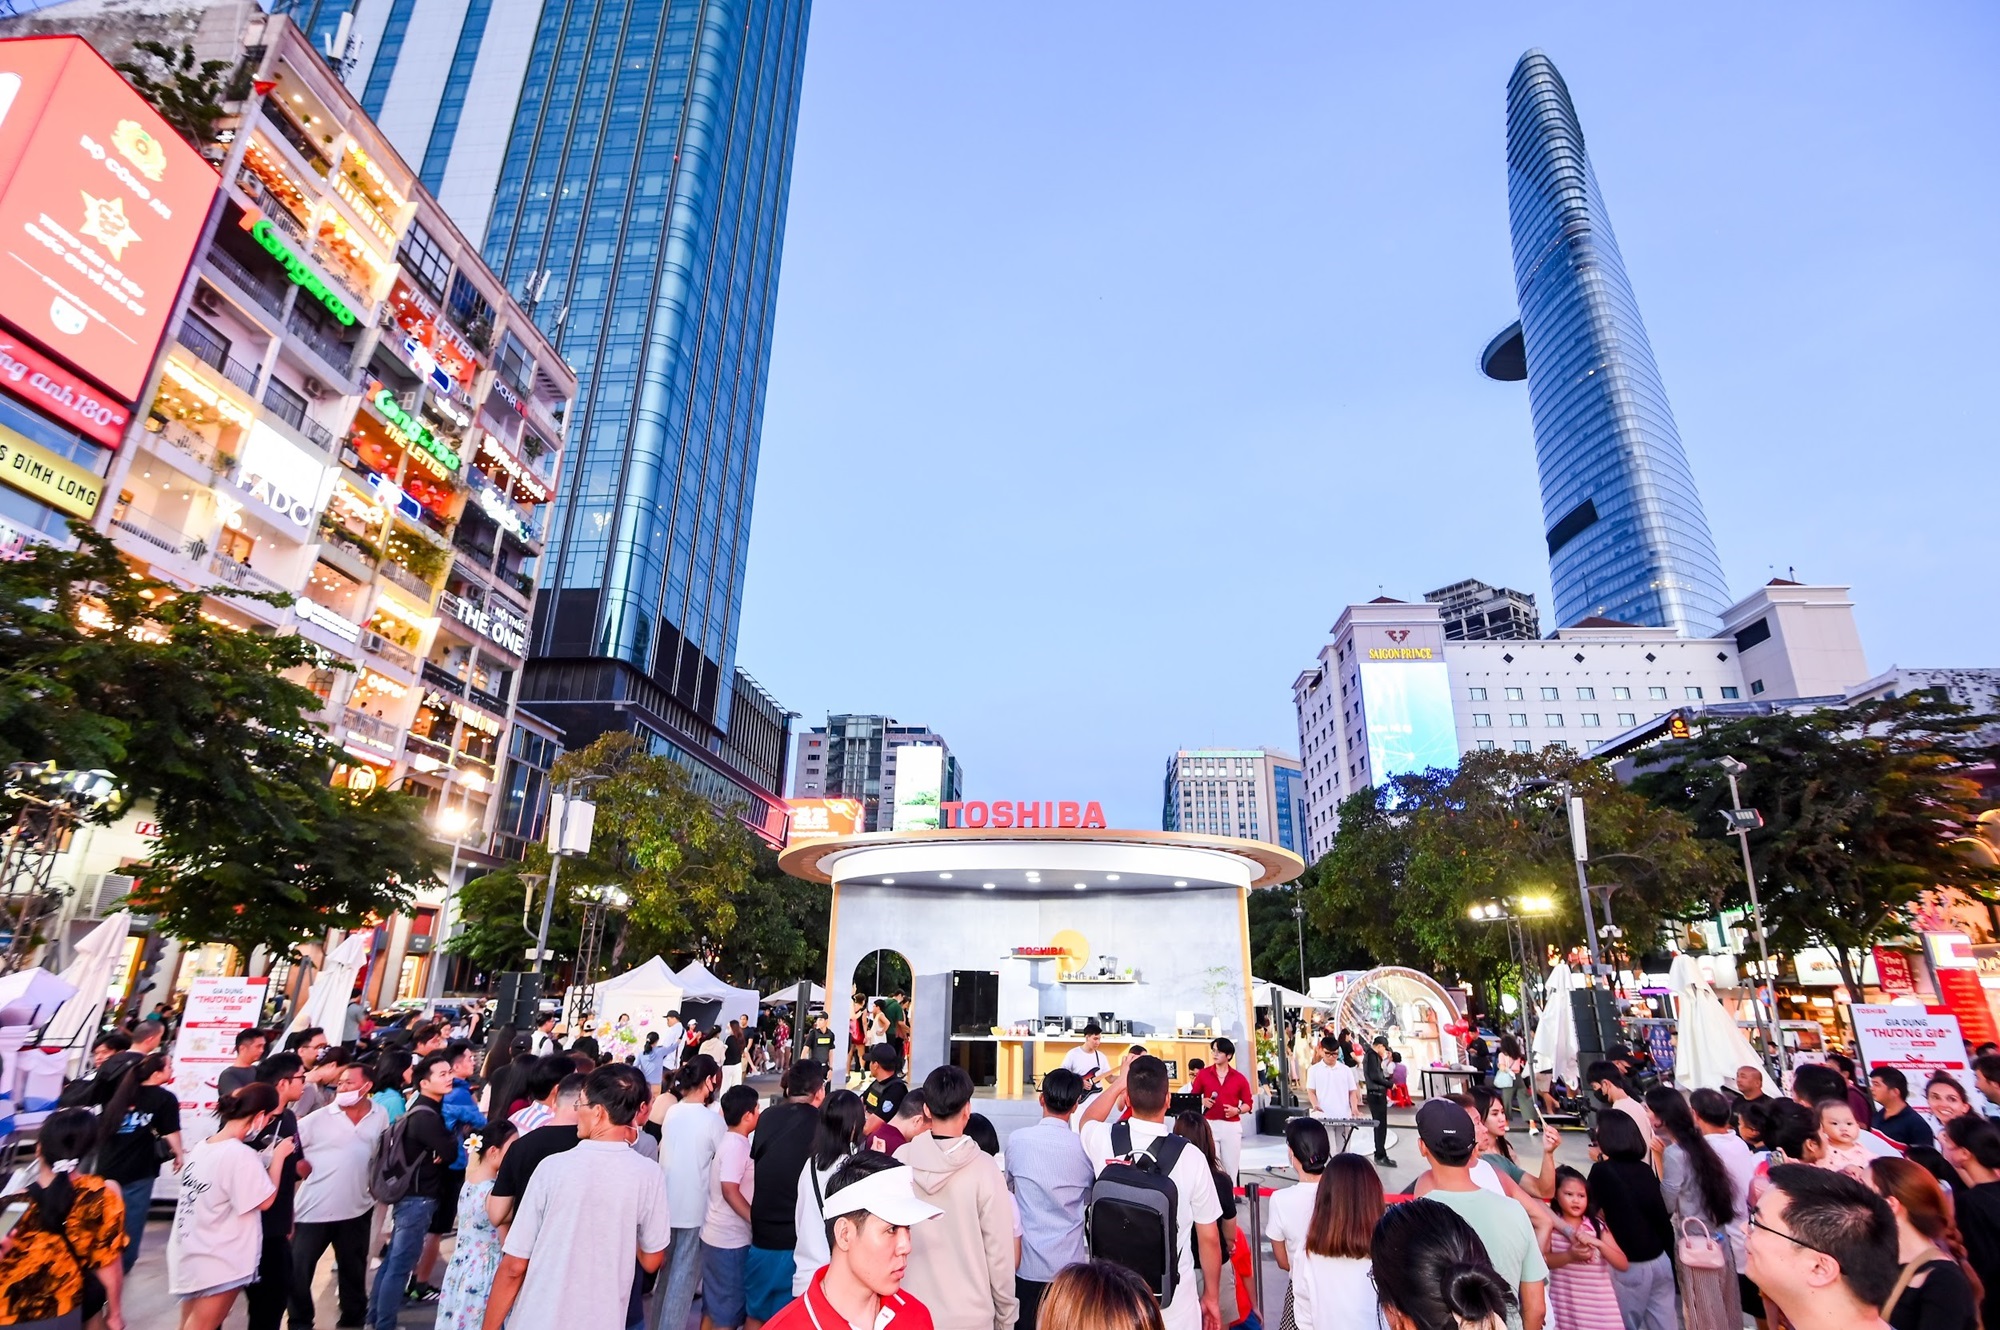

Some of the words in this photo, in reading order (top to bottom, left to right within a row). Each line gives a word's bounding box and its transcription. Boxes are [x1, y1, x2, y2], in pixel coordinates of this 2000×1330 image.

[409, 287, 437, 320] THE
[433, 314, 476, 363] LETTER
[384, 420, 409, 449] THE
[407, 441, 449, 481] LETTER
[57, 475, 98, 506] LONG
[457, 597, 490, 636] THE
[492, 622, 524, 658] ONE
[1369, 647, 1400, 660] SAIGON
[1401, 647, 1433, 660] PRINCE
[940, 801, 1107, 829] TOSHIBA
[1018, 947, 1066, 956] TOSHIBA
[1885, 1019, 1900, 1027] GIA
